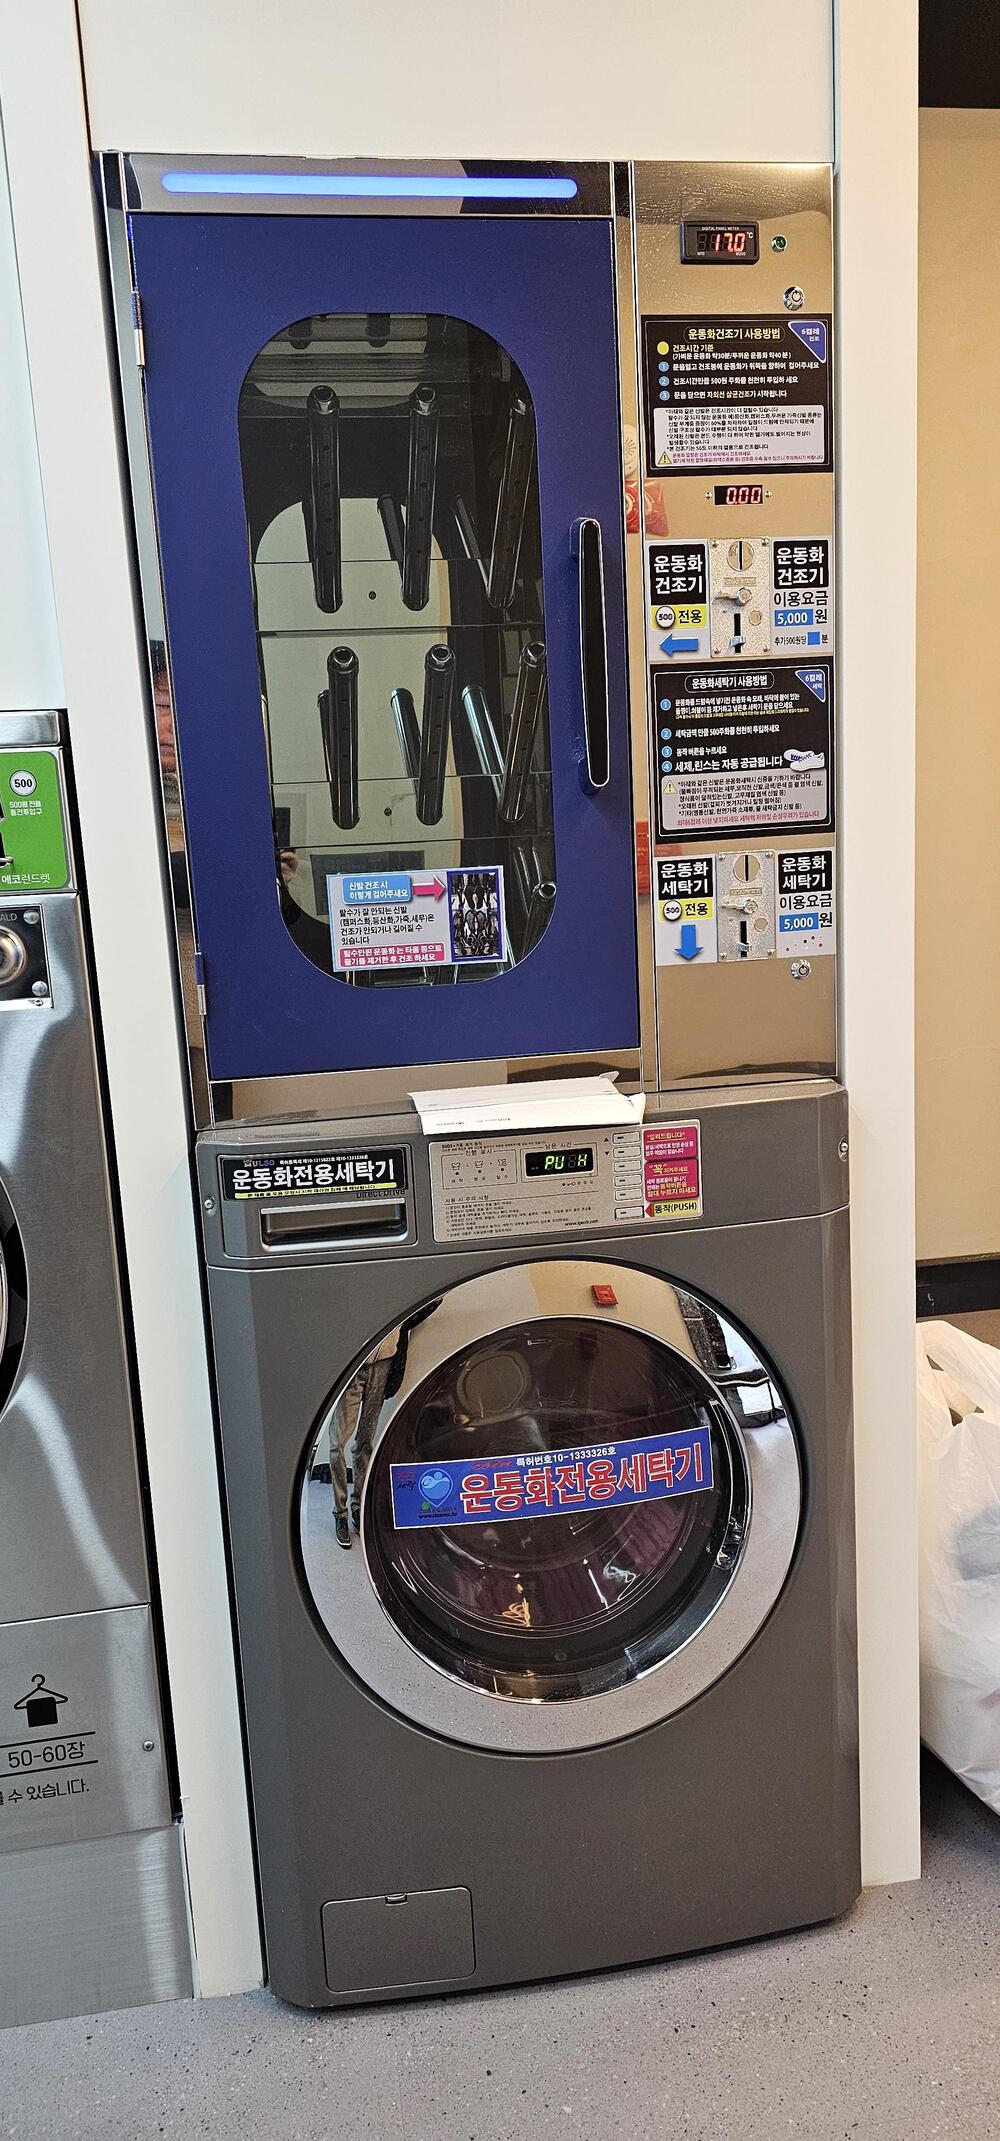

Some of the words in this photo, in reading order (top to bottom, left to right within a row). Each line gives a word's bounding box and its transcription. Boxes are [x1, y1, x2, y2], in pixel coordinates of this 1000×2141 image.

[688, 327, 743, 340] 운동화건조기
[744, 327, 781, 339] 사용방법
[672, 344, 700, 352] 건조시간
[700, 344, 714, 352] 기준
[750, 352, 768, 360] 운동화
[788, 362, 819, 370] 걸어주세요
[710, 377, 727, 385] 500원
[707, 391, 725, 399] 자외선
[776, 546, 824, 565] 운동화
[654, 554, 703, 574] 운동화
[777, 566, 824, 586] 건조기
[655, 575, 703, 594] 건조기
[774, 591, 828, 607] 이용요금
[659, 613, 673, 621] 500
[678, 608, 702, 625] 전용
[777, 611, 808, 626] 5,000
[814, 609, 828, 624] 원
[692, 676, 737, 689] 운동화세탁기
[737, 675, 768, 687] 사용방법
[753, 724, 780, 734] 투입하세요
[705, 745, 727, 755] 누르세요
[675, 760, 721, 773] 세제,린스는
[722, 759, 738, 770] 자동
[740, 756, 783, 769] 공급됩니다
[14, 778, 32, 788] 500
[9, 800, 28, 808] 500원
[10, 808, 42, 816] 동전투입구
[660, 861, 708, 878] 운동화
[782, 855, 827, 873] 운동화
[1, 873, 50, 885] 에코런드렛
[349, 881, 365, 890] 신발
[365, 881, 380, 890] 건조
[381, 880, 388, 889] 시
[782, 872, 826, 890] 세탁기
[661, 879, 708, 896] 세탁기
[349, 891, 372, 900] 이렇게
[372, 889, 408, 899] 걸어주세요
[780, 893, 832, 910] 이용요금
[339, 908, 361, 917] 탈수가
[362, 907, 370, 916] 잘
[371, 906, 392, 916] 안되는
[393, 906, 407, 915] 신발
[666, 906, 680, 914] 500
[685, 902, 708, 916] 전용
[784, 915, 814, 930] 5,000
[819, 911, 832, 928] 원
[341, 926, 362, 936] 건조가
[364, 925, 392, 935] 안되거나
[393, 924, 414, 933] 길어질
[415, 924, 423, 932] 수
[342, 936, 370, 945] 있습니다
[368, 955, 389, 965] 제거한
[390, 955, 396, 964] 후
[399, 954, 413, 963] 건조
[414, 953, 436, 963] 하세요
[232, 1158, 394, 1190] 운동화전용세탁기
[655, 1202, 697, 1214] 동작(PUSH)
[516, 1445, 616, 1468] 특허번호10-1333326호
[459, 1442, 702, 1515] 운동화전용세탁기
[8, 1740, 85, 1769] 50-60장
[8, 1787, 23, 1803] 수
[26, 1777, 90, 1801] 있습니다.
